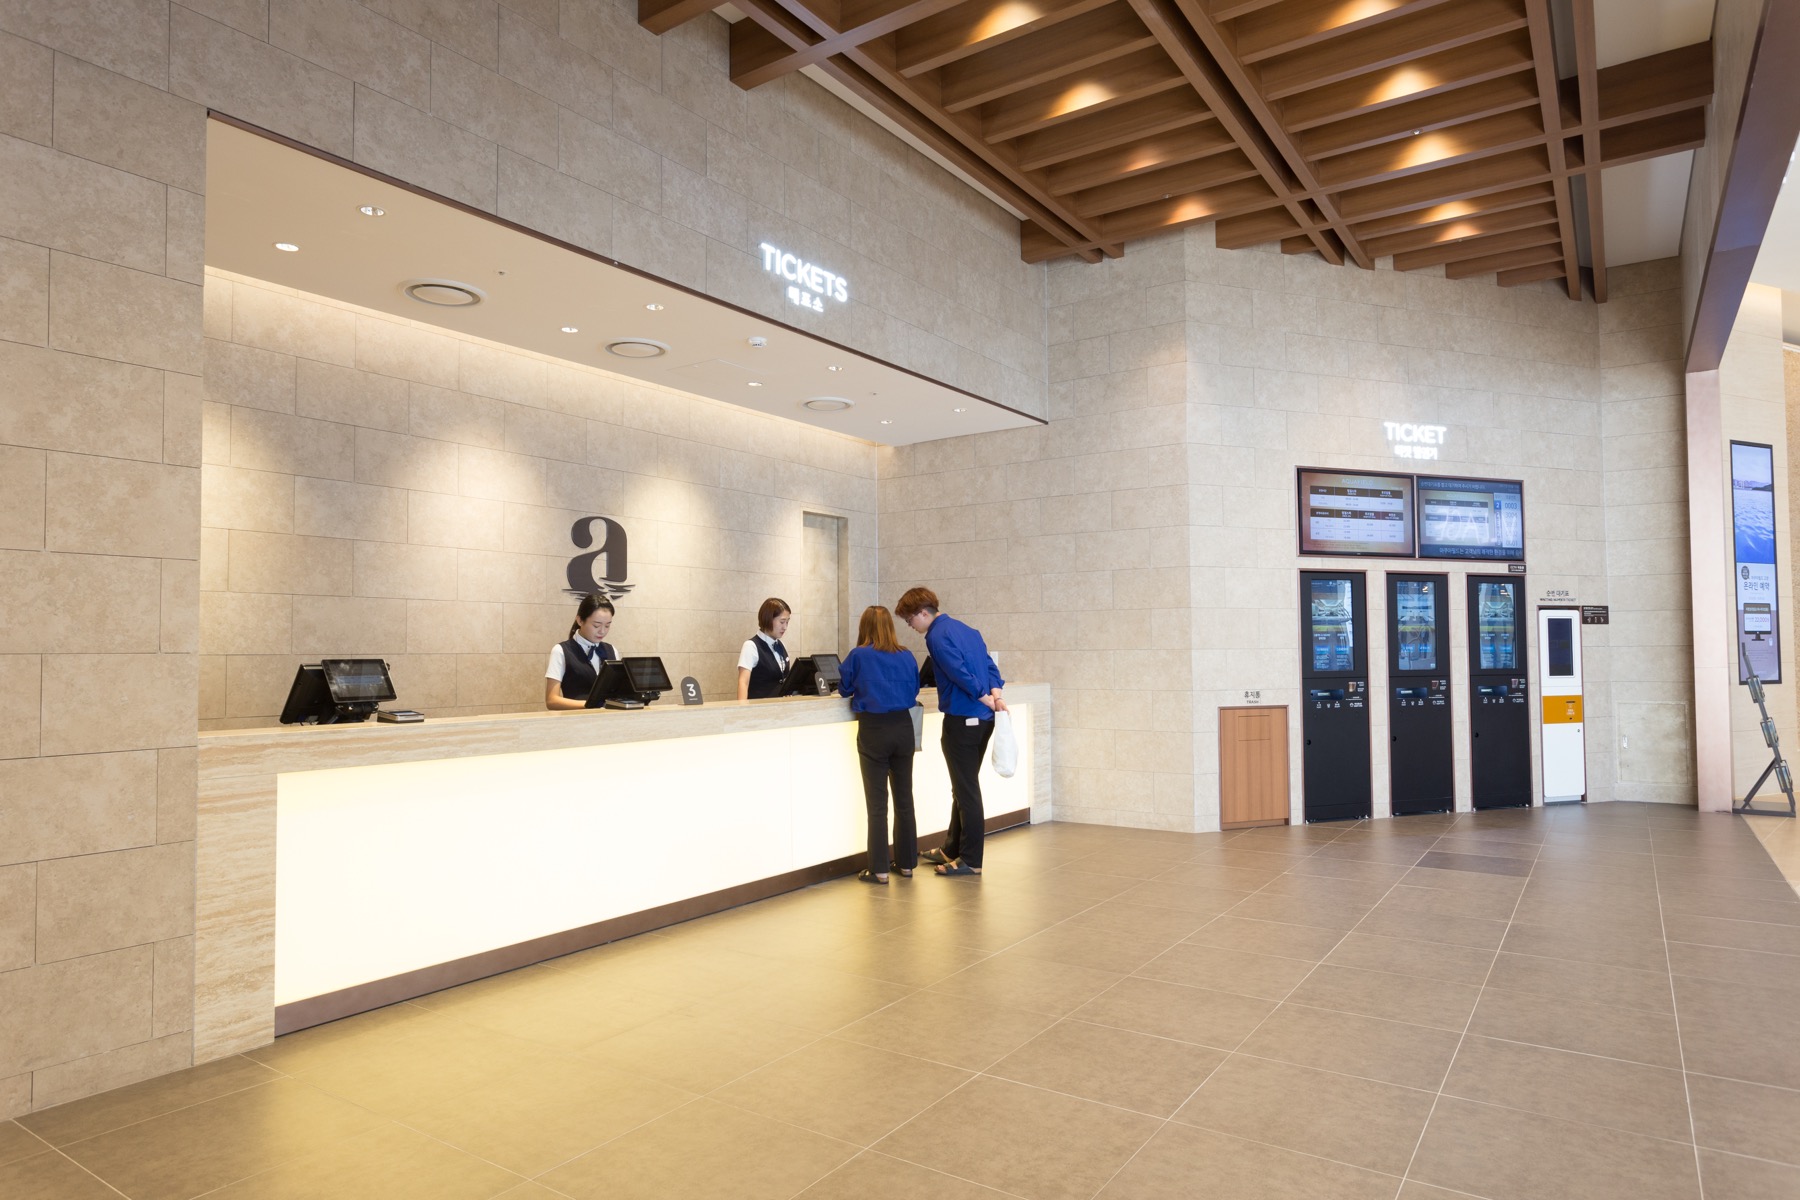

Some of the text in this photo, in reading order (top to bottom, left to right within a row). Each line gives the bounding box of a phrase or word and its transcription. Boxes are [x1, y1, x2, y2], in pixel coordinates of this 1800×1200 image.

[760, 242, 848, 303] TICKETS
[1383, 422, 1447, 445] TICKET
[686, 683, 696, 697] 3
[818, 677, 826, 689] 2
[1244, 690, 1261, 699] 휴지통
